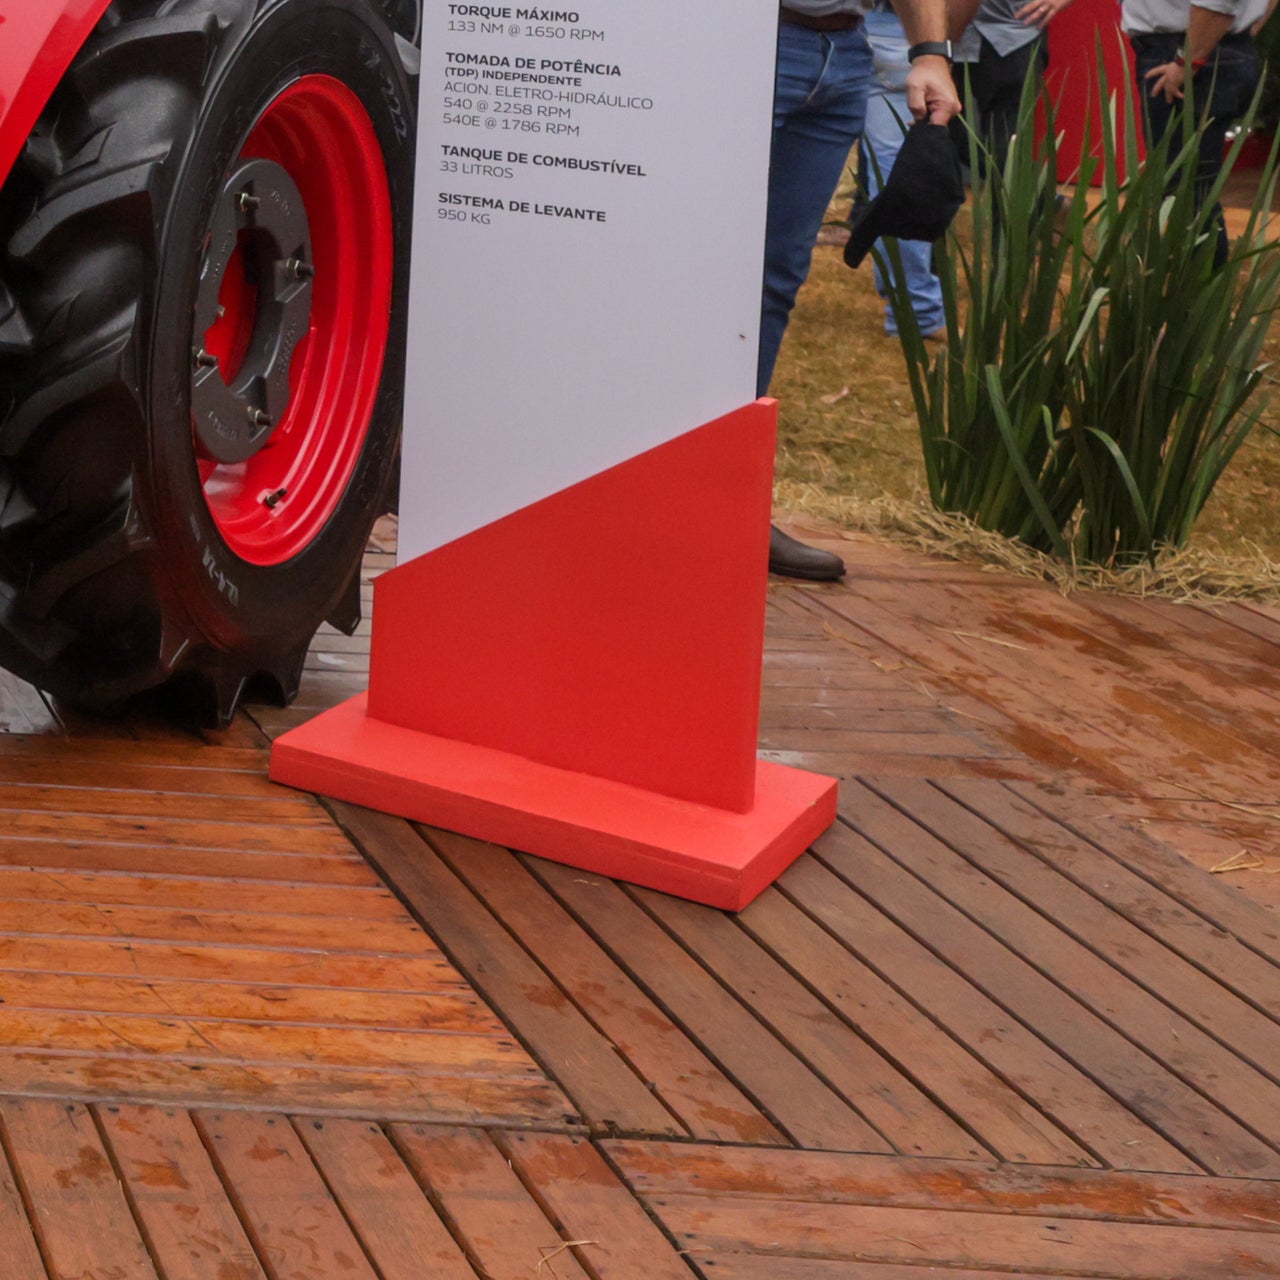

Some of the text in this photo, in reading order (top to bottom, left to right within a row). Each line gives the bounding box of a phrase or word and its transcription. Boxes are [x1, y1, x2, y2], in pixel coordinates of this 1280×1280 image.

[448, 4, 579, 23] TORQUE MÁXIMO
[447, 20, 605, 41] 133 NM @ 1650 RPM
[445, 52, 622, 76] TOMADA DE POTÊNCIA
[444, 67, 582, 86] (TDP) INDEPENDENTE
[444, 81, 653, 109] ACION. ELETRO-HIDRÁULICO
[443, 97, 571, 118] 540 @ 2258 RPM
[442, 113, 580, 136] 540E @ 1786 RPM
[440, 160, 514, 179] 33 LITROS
[441, 144, 646, 176] TANQUE DE COMBUSTÍVEL
[438, 192, 606, 222] SISTEMA DE LEVANTE
[438, 208, 491, 225] 950 KG
